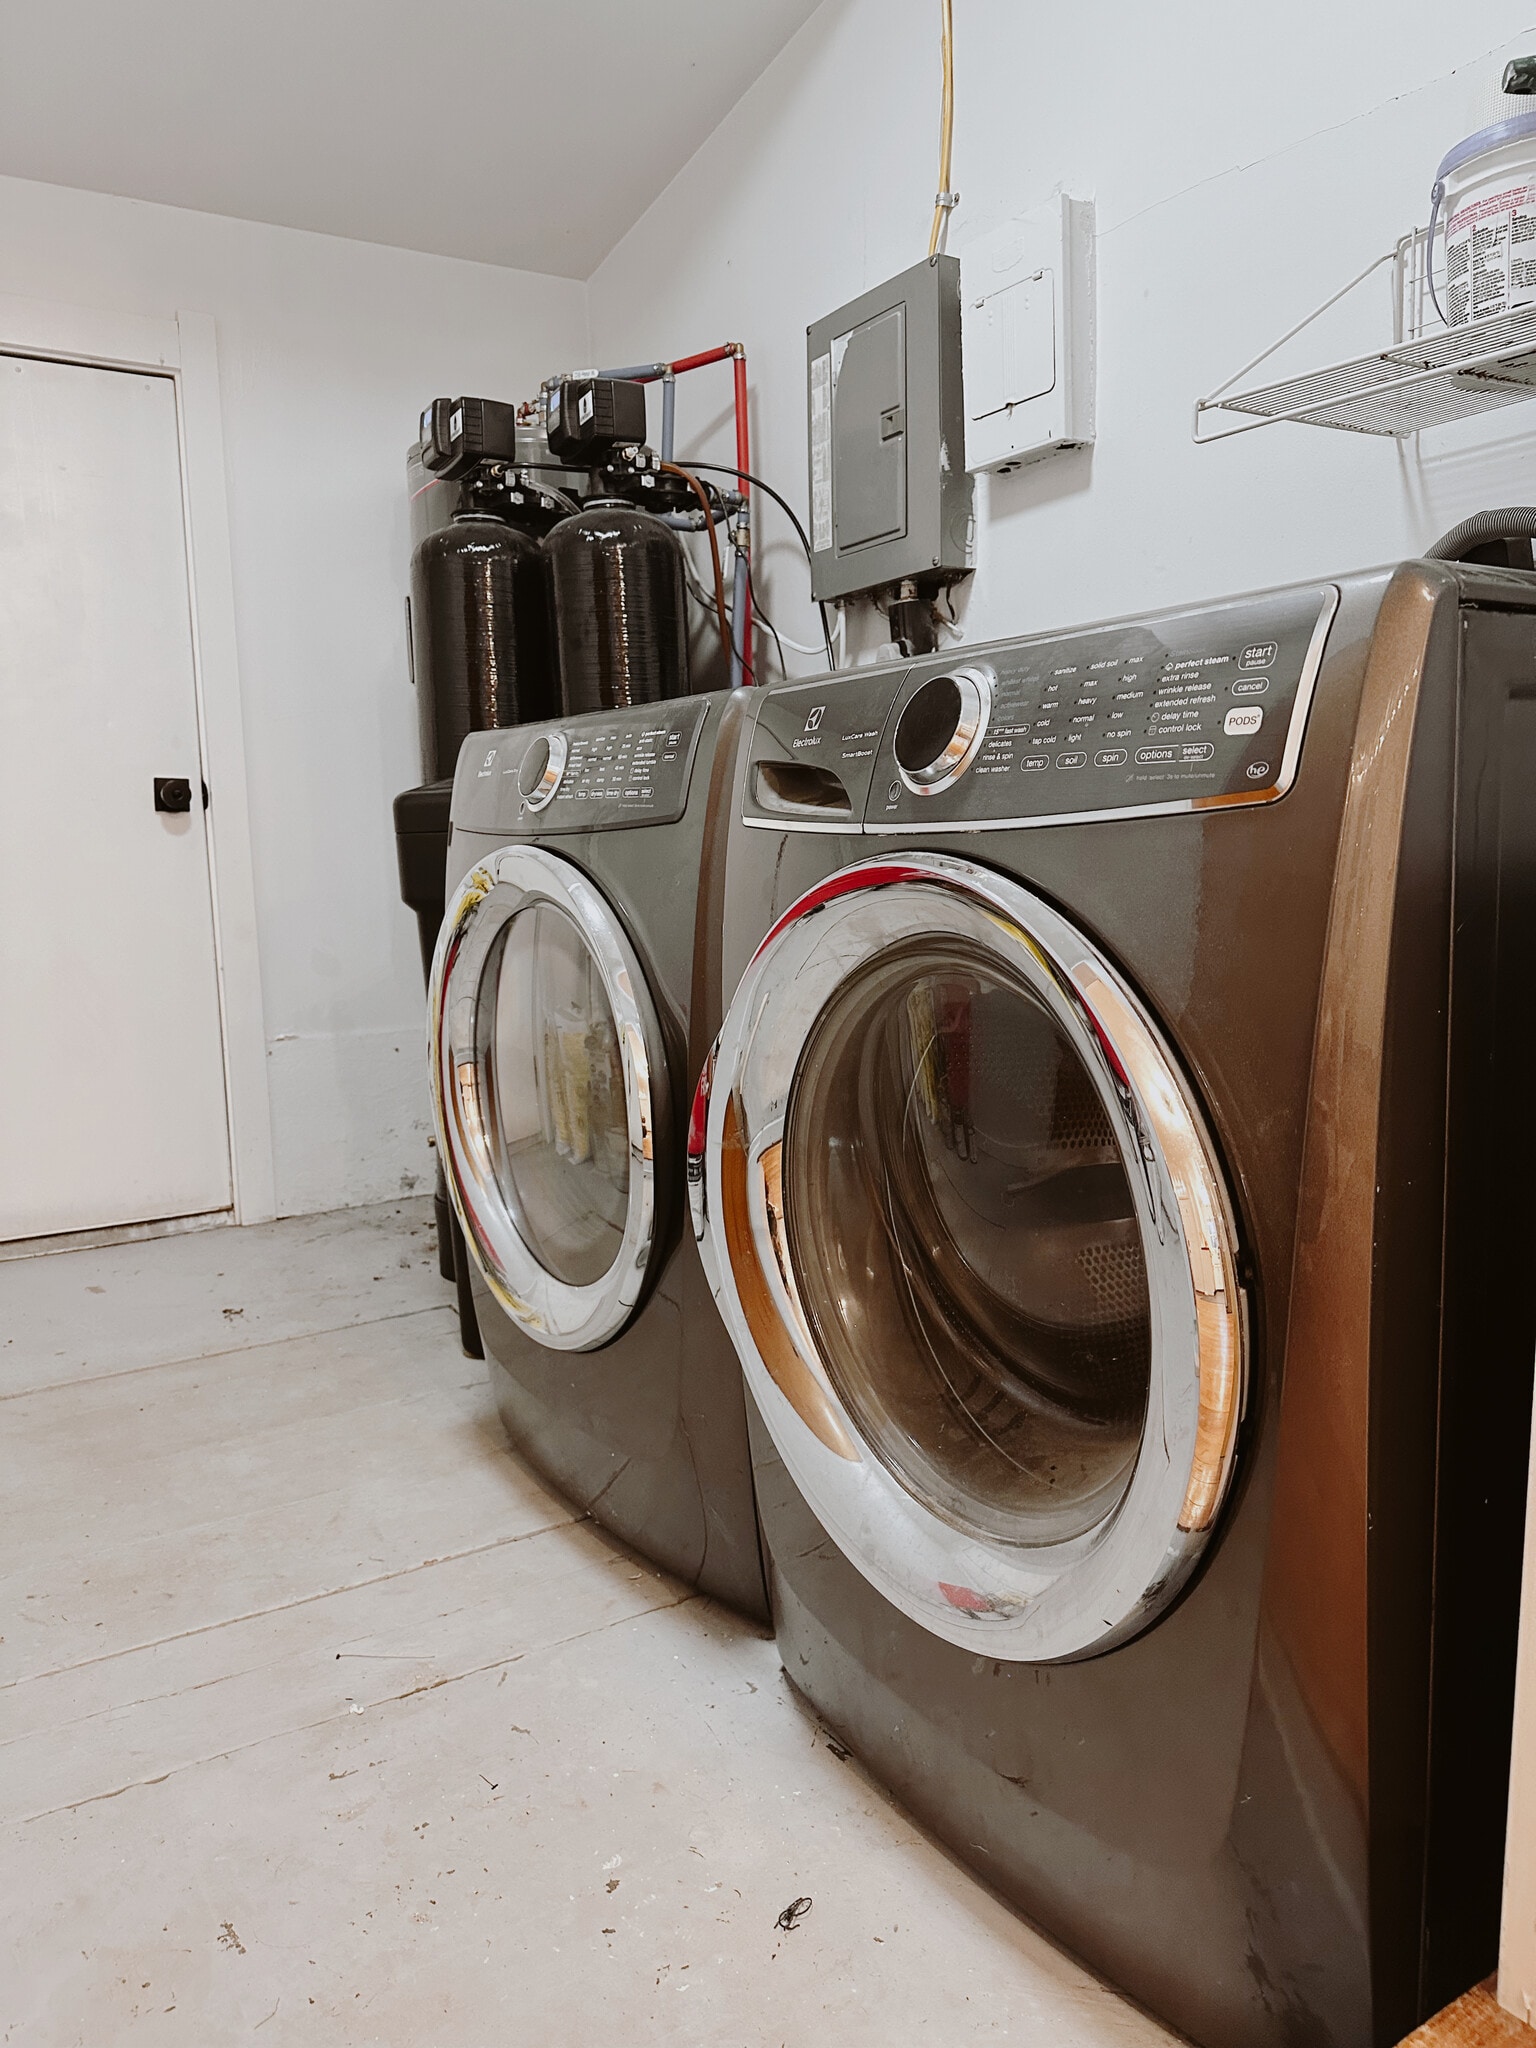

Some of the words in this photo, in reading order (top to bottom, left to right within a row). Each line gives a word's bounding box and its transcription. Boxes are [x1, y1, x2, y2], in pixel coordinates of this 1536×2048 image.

[1512, 209, 1517, 217] 3
[1244, 645, 1273, 659] start
[1090, 660, 1106, 670] solid
[1106, 659, 1119, 668] soil
[1128, 656, 1144, 664] max
[1174, 659, 1203, 671] perfect
[1203, 655, 1230, 665] steam
[1053, 666, 1077, 676] sanitize
[1122, 673, 1137, 683] high
[1161, 674, 1180, 683] extra
[1180, 671, 1200, 681] rinse
[1047, 684, 1059, 693] hot
[1083, 680, 1098, 688] max
[1158, 685, 1184, 695] wrinkle
[1184, 682, 1212, 693] release
[1237, 682, 1263, 692] cancel
[1116, 691, 1144, 701] medium
[1042, 701, 1059, 710] warm
[1078, 697, 1098, 706] heavy
[1154, 697, 1189, 709] extended
[1189, 694, 1217, 705] refresh
[1072, 713, 1096, 724] normal
[1111, 711, 1124, 720] low
[1161, 712, 1181, 721] delay
[1182, 710, 1200, 719] time
[1036, 718, 1051, 728] cold
[1158, 724, 1185, 734] control
[1185, 722, 1203, 732] lock
[1067, 733, 1082, 743] light
[1106, 731, 1116, 739] no
[1116, 728, 1132, 739] spin
[792, 735, 823, 748] Electrolux
[987, 740, 1013, 748] delicates
[1042, 735, 1057, 744] cold
[1139, 749, 1173, 761] options
[1182, 745, 1208, 755] select
[1001, 752, 1014, 761] spin
[1064, 755, 1079, 765] soil
[1101, 751, 1120, 764] spin
[1026, 759, 1045, 769] temp
[975, 766, 990, 774] clean
